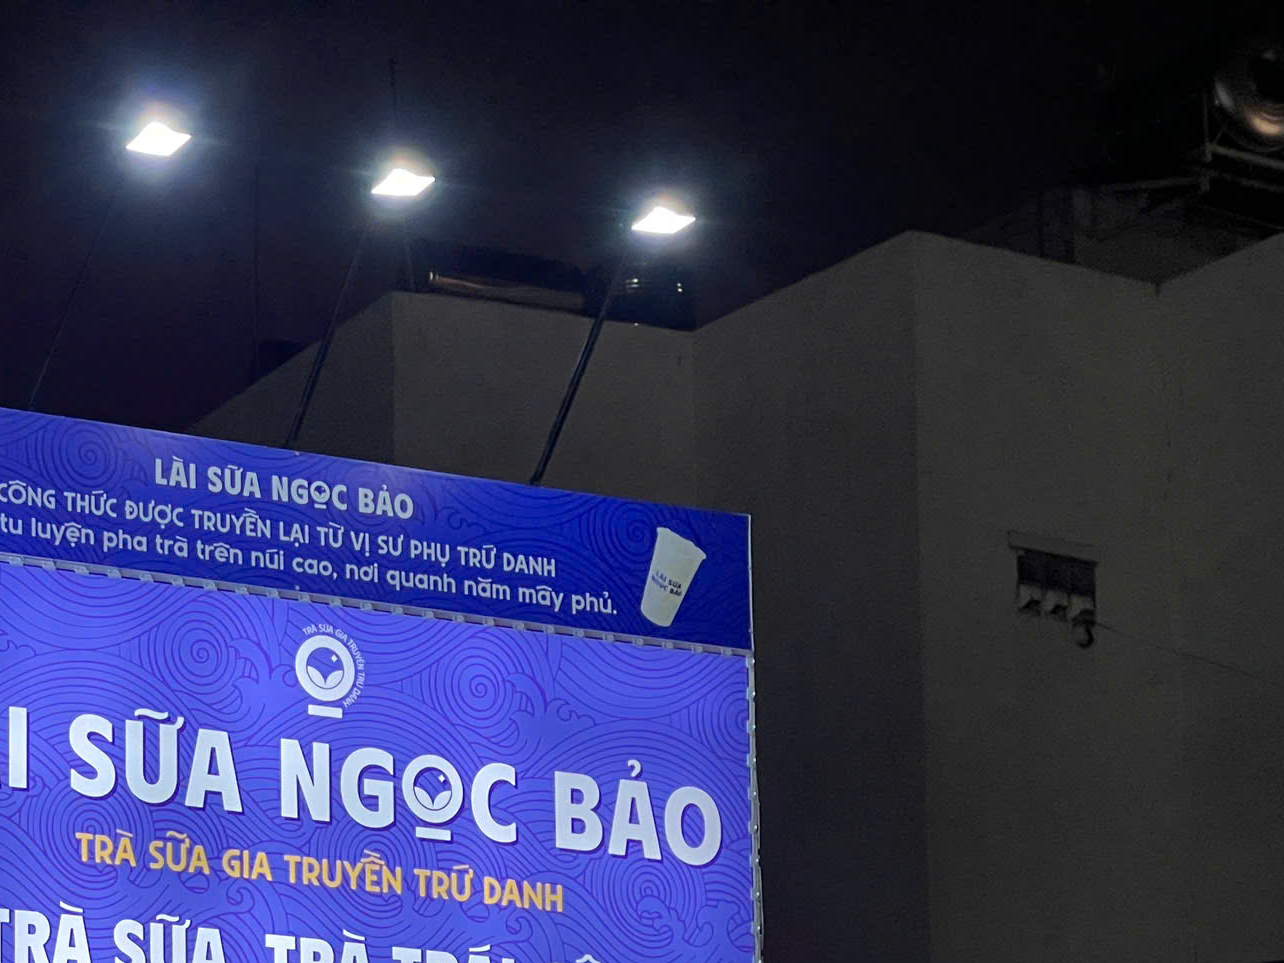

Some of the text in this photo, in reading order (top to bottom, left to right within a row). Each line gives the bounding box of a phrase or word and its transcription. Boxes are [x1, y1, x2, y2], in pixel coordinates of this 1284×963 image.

[155, 456, 414, 520] LÀI SỮA NGỌC BẢO
[0, 513, 23, 535] tu
[31, 517, 95, 547] luyện
[103, 529, 147, 552] pha
[156, 534, 188, 557] trà
[197, 540, 243, 564] trên
[251, 549, 284, 571] núi
[292, 557, 338, 580] cao,
[346, 563, 379, 583] nơi
[386, 569, 456, 593] quanh
[464, 576, 511, 601] năm
[518, 584, 563, 612] mây
[571, 591, 617, 615] phủ.
[63, 490, 117, 518] THỨC
[124, 500, 184, 529] ĐƯỢC
[191, 507, 271, 539] TRUYỀN
[279, 521, 310, 547] LẠI
[316, 521, 344, 548] TỪ
[350, 531, 370, 557] VỊ
[377, 534, 404, 557] SƯ
[410, 539, 450, 567] PHỤ
[503, 552, 555, 577] DANH
[68, 707, 244, 813] SỮA
[280, 738, 516, 843] NGỌC
[554, 759, 722, 867] BẢO
[75, 828, 563, 912] TRÀ SỮA GIA TRUYỀN TRỨ DANH
